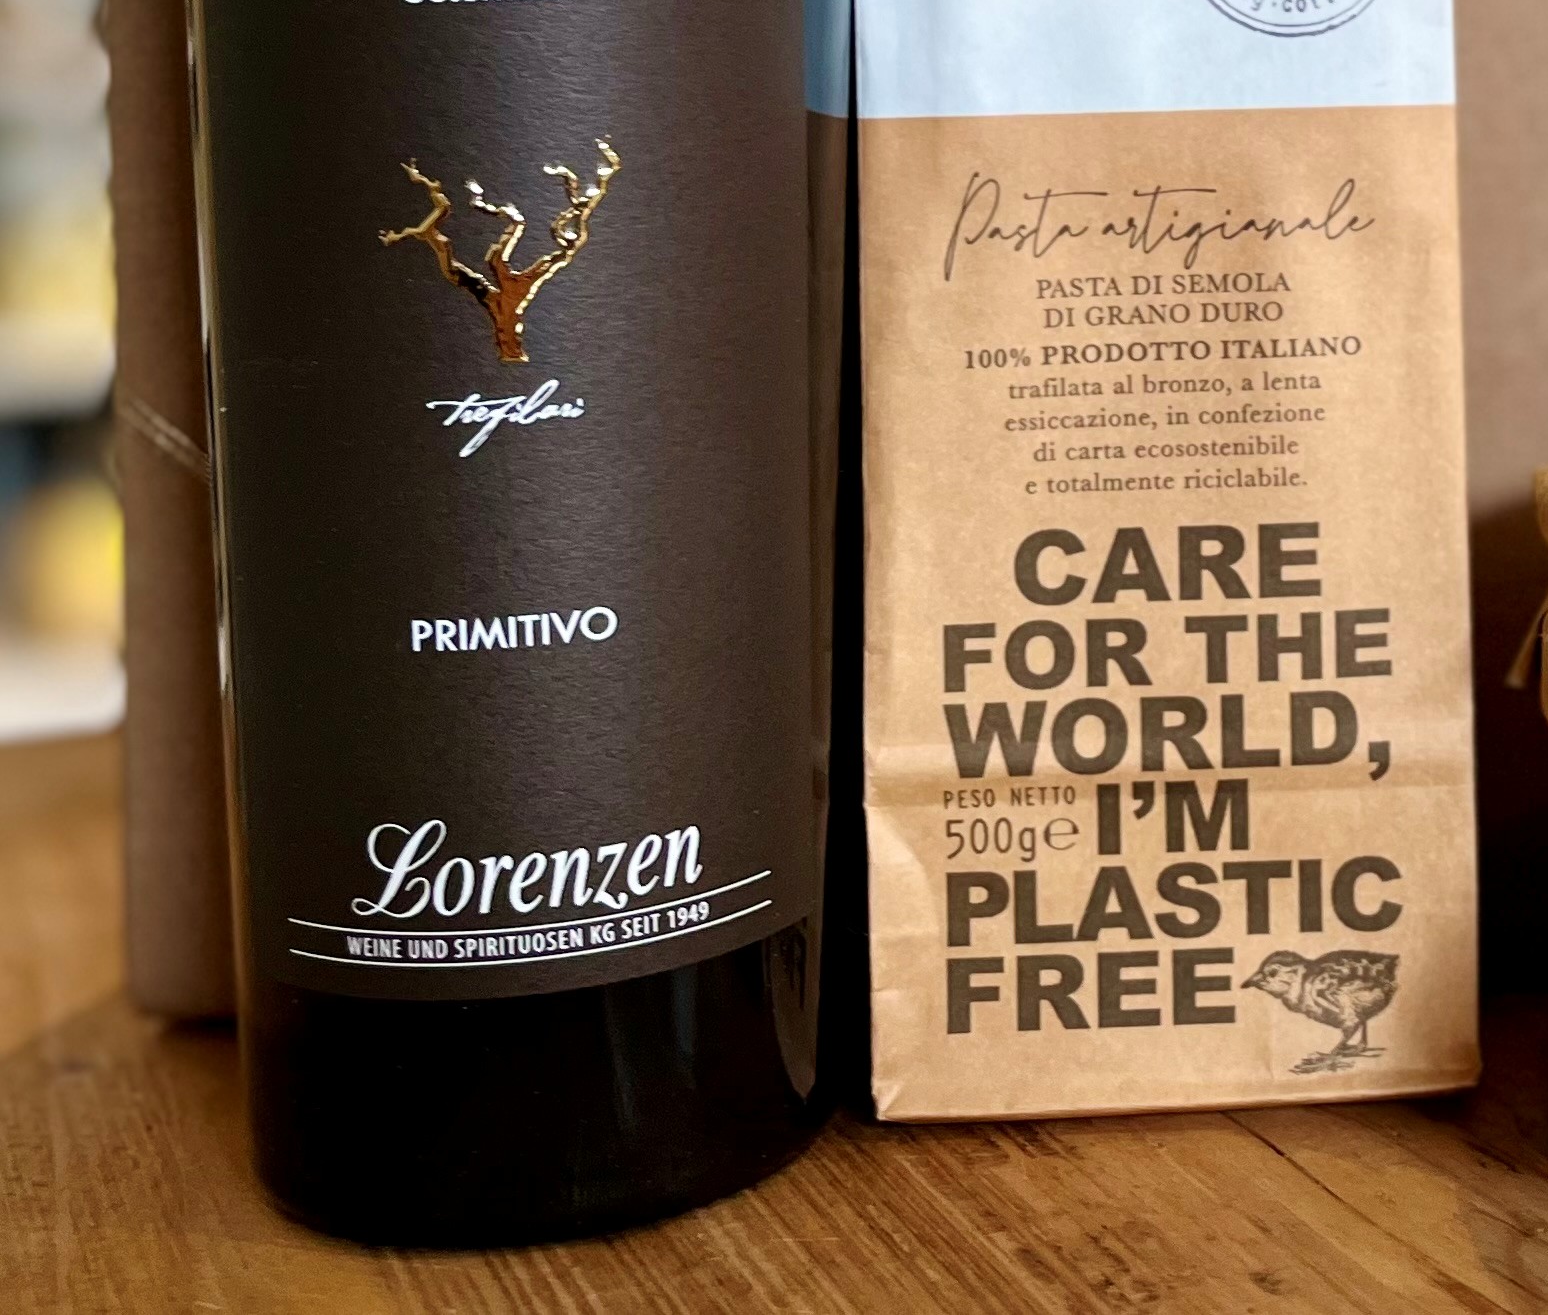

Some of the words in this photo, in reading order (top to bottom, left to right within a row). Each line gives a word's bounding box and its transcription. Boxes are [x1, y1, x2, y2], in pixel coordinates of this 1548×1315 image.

[1036, 276, 1123, 299] PASTA
[1131, 275, 1164, 296] DI
[1172, 272, 1291, 295] SEMOLA
[1043, 307, 1076, 329] DI
[1085, 303, 1192, 327] GRANO
[1200, 300, 1285, 324] DURO
[965, 348, 1032, 370] 100%
[1041, 340, 1212, 366] PRODOTTO
[1220, 334, 1363, 361] ITALIANO
[1009, 376, 1104, 399] trafilata
[1112, 373, 1134, 395] al
[1142, 372, 1233, 397] bronzo,
[1240, 375, 1256, 392] a
[1262, 370, 1322, 391] lenta
[1004, 407, 1159, 432] essiccazione,
[1166, 405, 1191, 426] in
[1198, 403, 1326, 426] confezione
[1033, 441, 1057, 463] di
[1065, 441, 1126, 461] carta
[1134, 436, 1300, 459] ecosostenibile
[1025, 478, 1039, 495] e
[1047, 472, 1176, 494] totalmente
[1183, 468, 1309, 491] riciclabile.
[1014, 522, 1322, 606] CARE
[411, 606, 619, 652] PRIMITIVO
[943, 617, 1153, 693] FOR
[1185, 607, 1393, 684] THE
[943, 689, 1392, 782] WORLD,
[943, 788, 996, 810] PESO
[1010, 785, 1077, 807] NETTO
[1097, 778, 1251, 856] I'M
[351, 819, 704, 919] Lorenzen
[945, 855, 1404, 948] PLASTIC
[346, 935, 403, 960] WEINE
[407, 938, 450, 961] UND
[453, 926, 585, 960] SPIRITUOSEN
[589, 921, 616, 945] KG
[620, 912, 662, 940] SEIT
[666, 900, 711, 929] 1949
[946, 946, 1238, 1035] FREE
